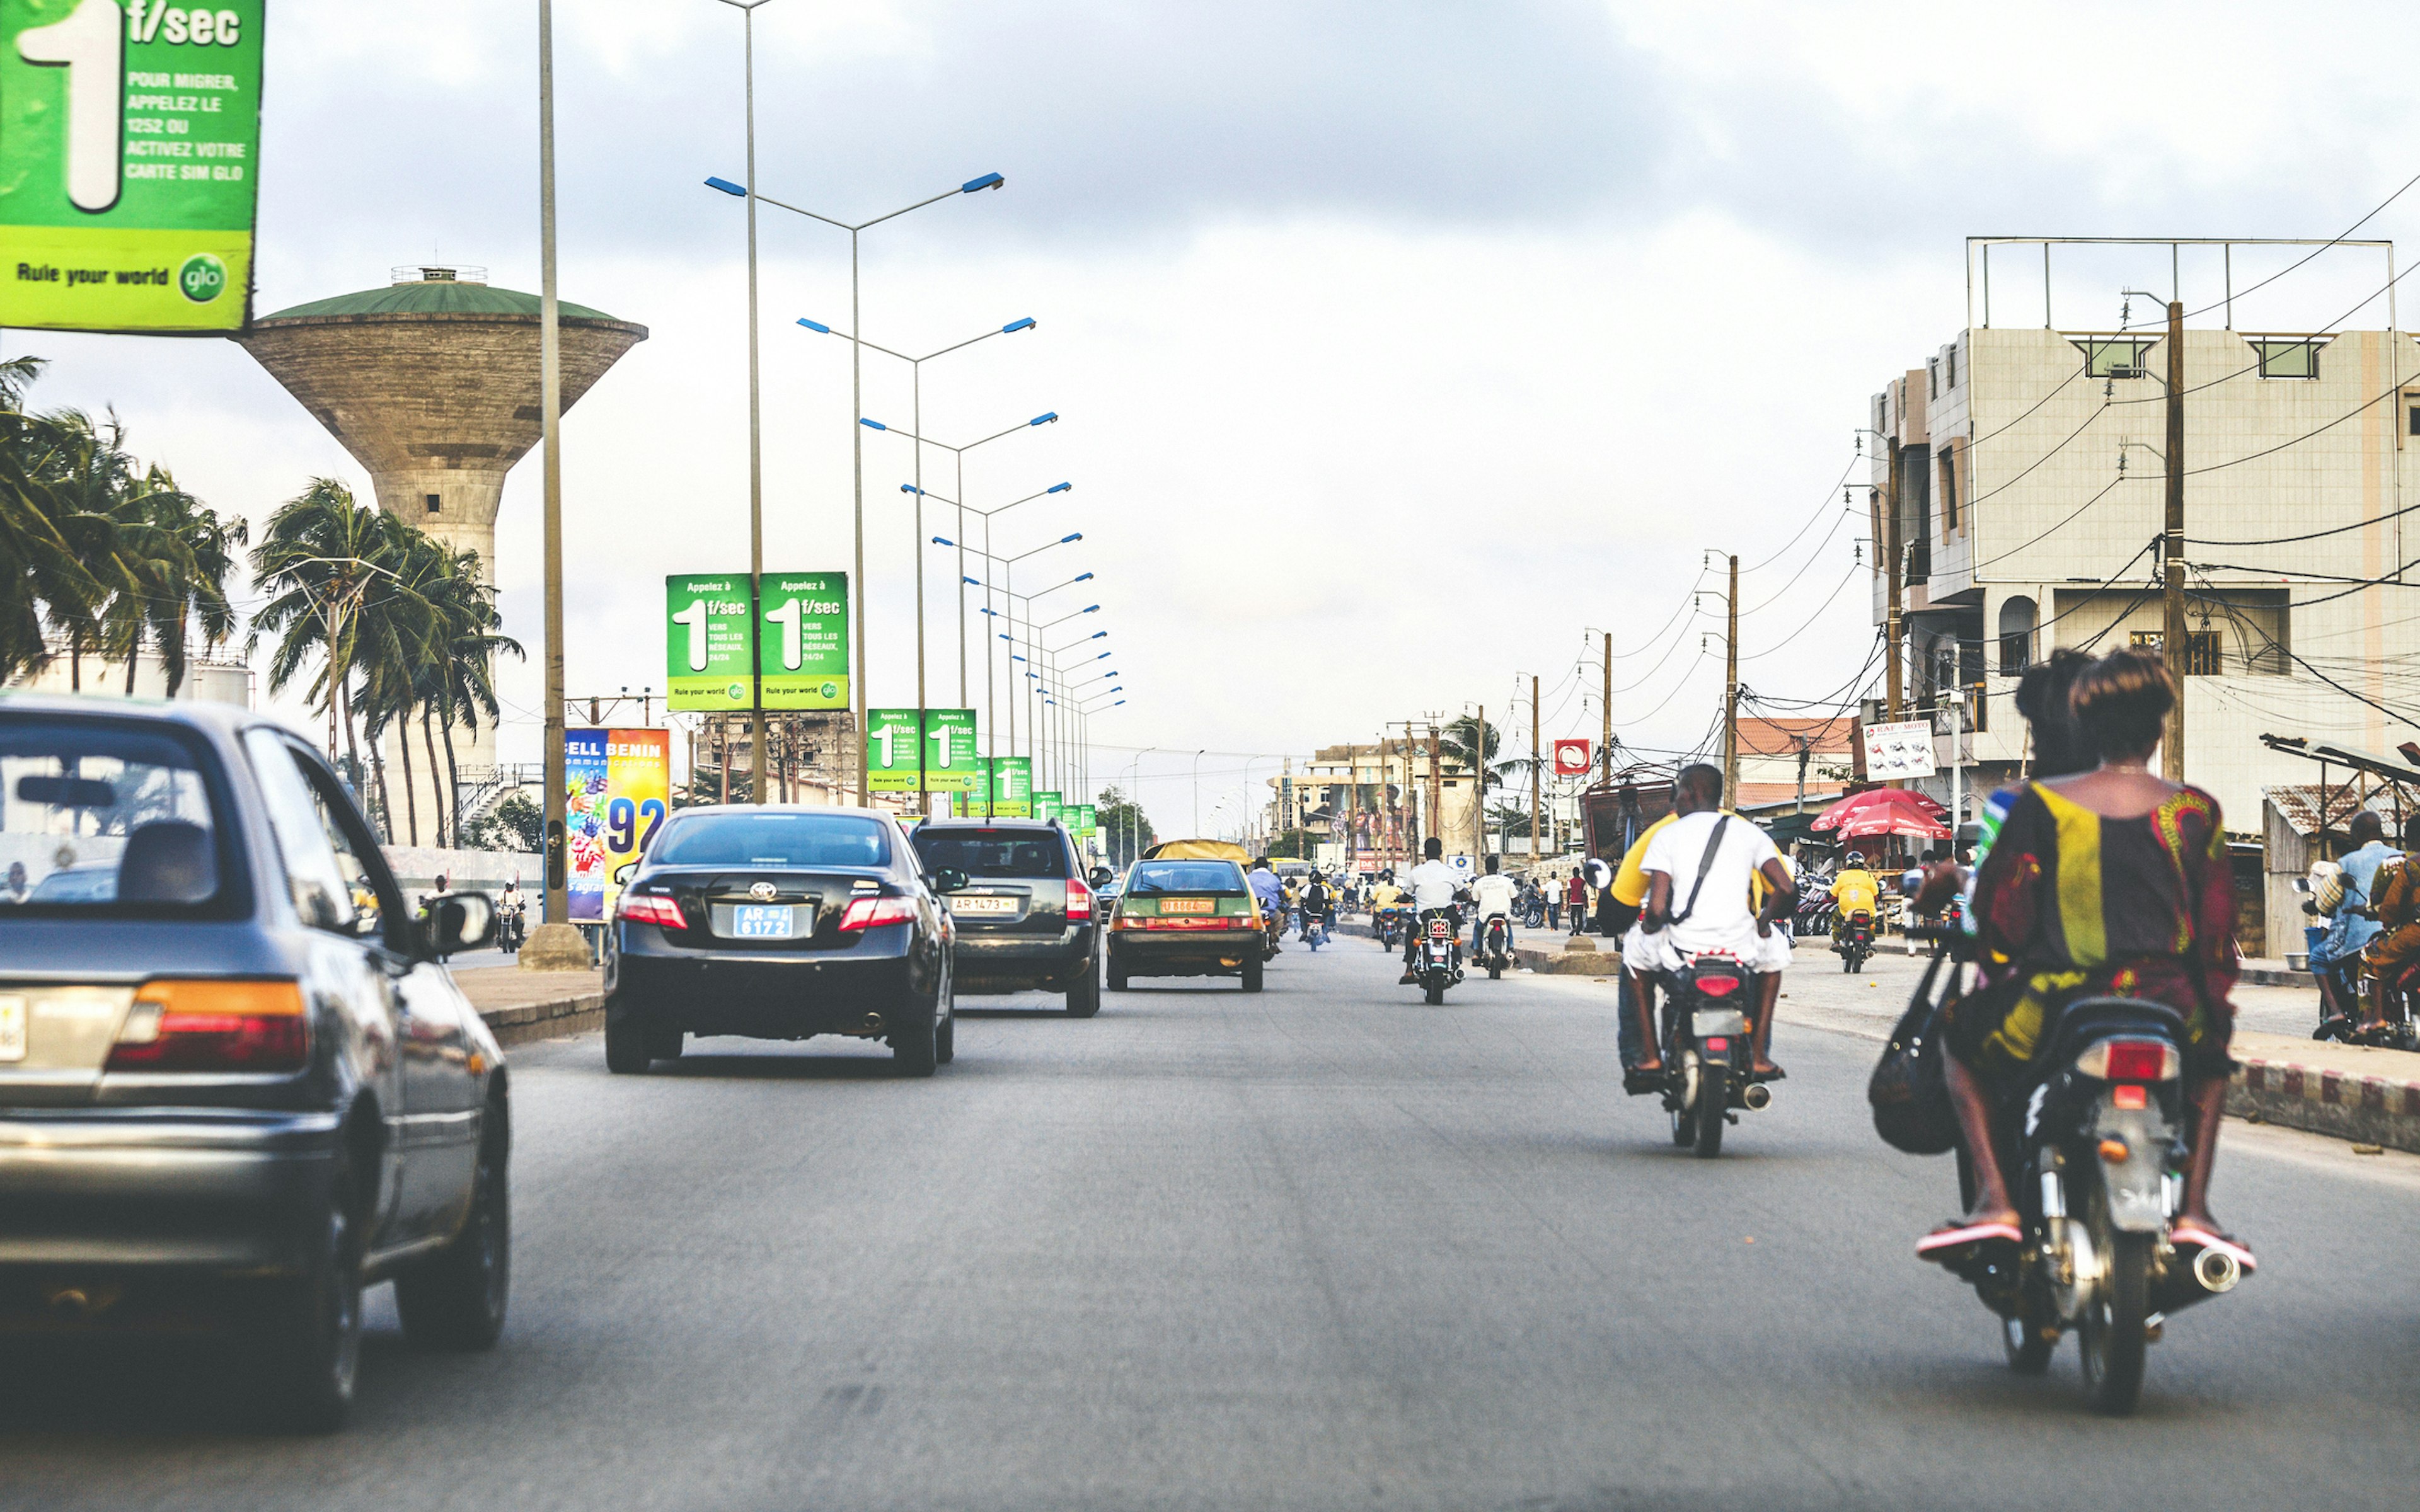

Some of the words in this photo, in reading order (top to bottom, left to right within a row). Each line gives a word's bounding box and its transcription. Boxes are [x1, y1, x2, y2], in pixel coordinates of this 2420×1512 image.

[127, 71, 170, 88] POUR
[174, 73, 239, 92] MIGRER,
[15, 0, 122, 211] 1
[127, 0, 240, 45] f/sec
[127, 94, 198, 112] APPELEZ
[202, 96, 222, 112] LE
[127, 118, 163, 134] 1252
[166, 119, 188, 134] OU
[126, 140, 192, 157] ACTIVEZ
[195, 143, 246, 158] VOTRE
[125, 163, 176, 179] CARTE
[180, 165, 209, 180] SIM
[212, 165, 243, 181] GLO
[17, 263, 60, 282] Rule
[66, 269, 108, 287] your
[115, 268, 168, 285] world
[186, 266, 219, 292] glo
[687, 582, 722, 593] Appelez
[725, 581, 731, 591] à
[781, 581, 817, 593] Appelez
[819, 580, 826, 590] à
[672, 599, 706, 670] 1
[707, 600, 746, 616] f/sec
[765, 598, 801, 670] 1
[802, 599, 841, 615] f/sec
[880, 713, 902, 721] Appelez
[606, 743, 661, 759] BENIN
[871, 724, 892, 767] 1
[893, 724, 916, 735] f/sec
[928, 724, 950, 767] 1
[950, 725, 973, 735] f/sec
[565, 758, 660, 768] ommunications
[609, 798, 665, 853] 92
[976, 886, 994, 895] Jeep
[957, 900, 971, 909] AR
[975, 900, 1000, 909] 1473
[744, 908, 764, 920] AR
[742, 921, 785, 934] 6172
